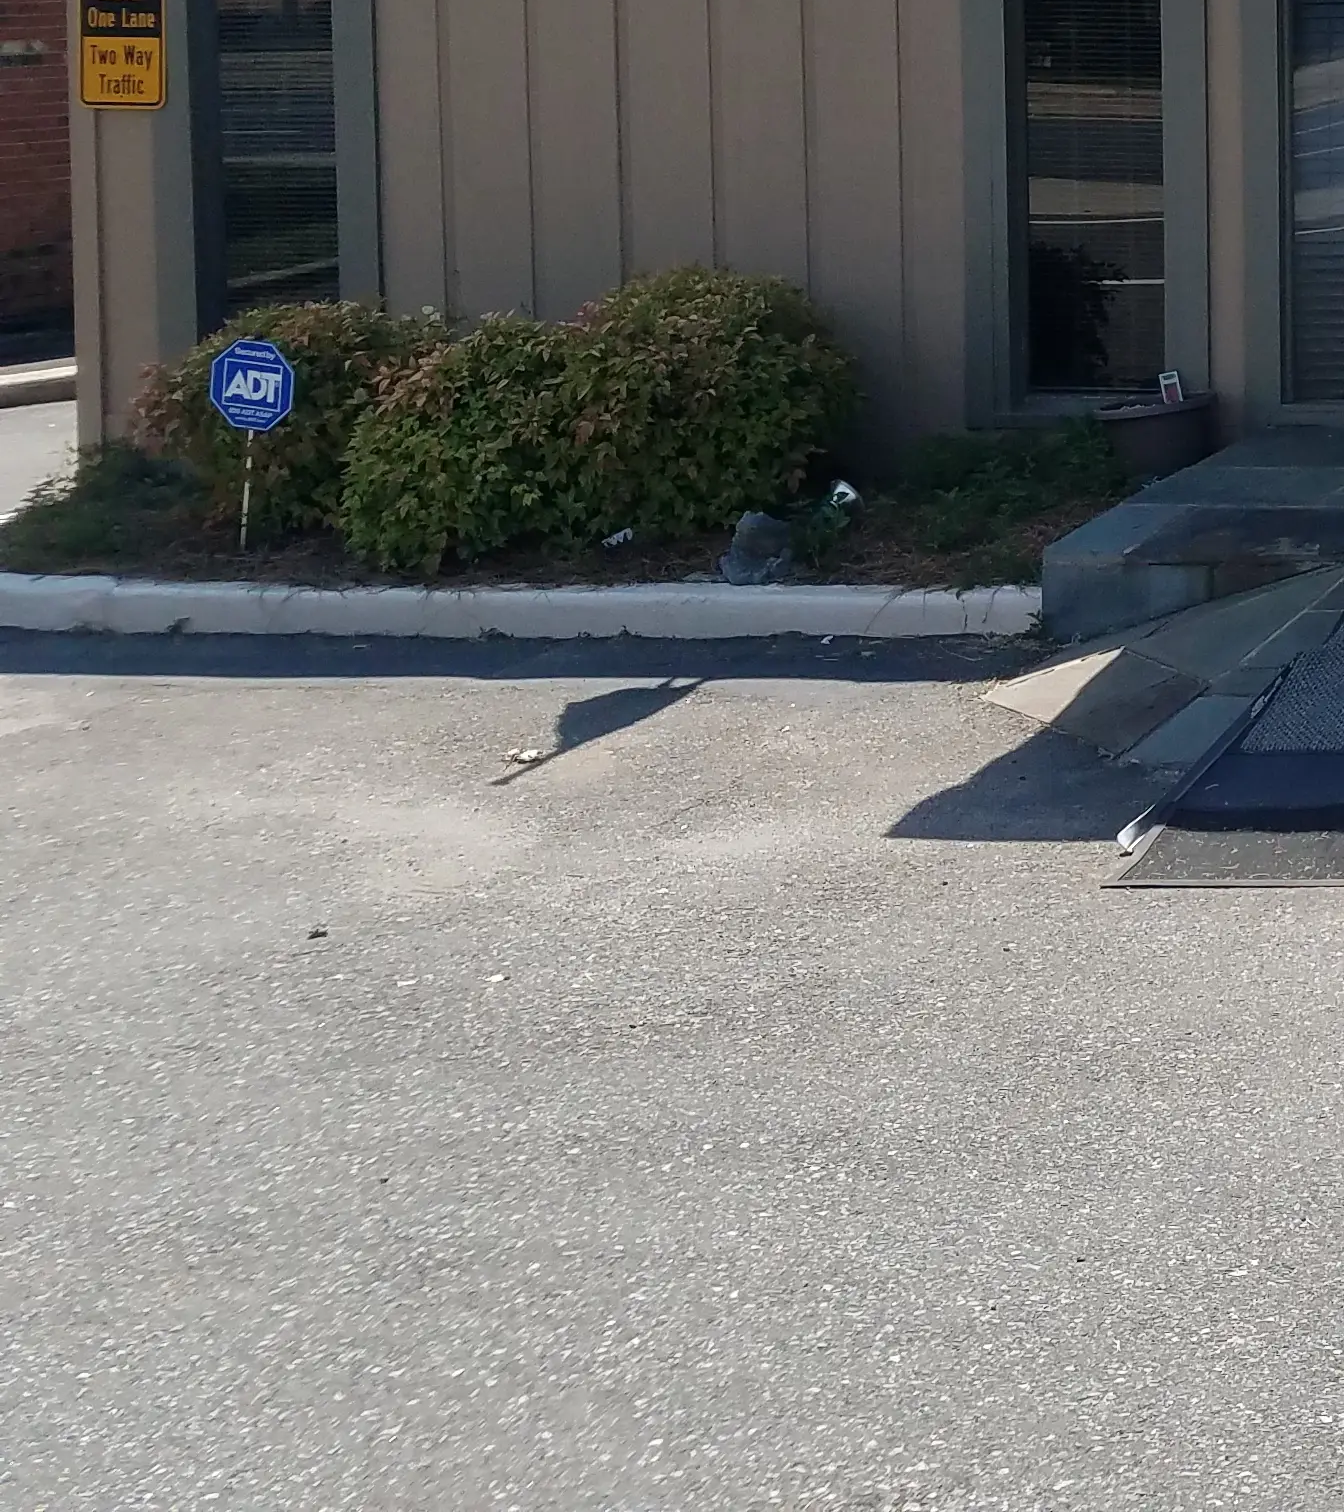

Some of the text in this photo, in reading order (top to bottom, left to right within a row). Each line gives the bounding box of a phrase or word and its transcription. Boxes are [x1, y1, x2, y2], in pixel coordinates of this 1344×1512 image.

[88, 6, 155, 28] One Lane
[90, 45, 152, 71] Two Way
[98, 74, 145, 95] Traffic
[224, 369, 282, 403] ADT
